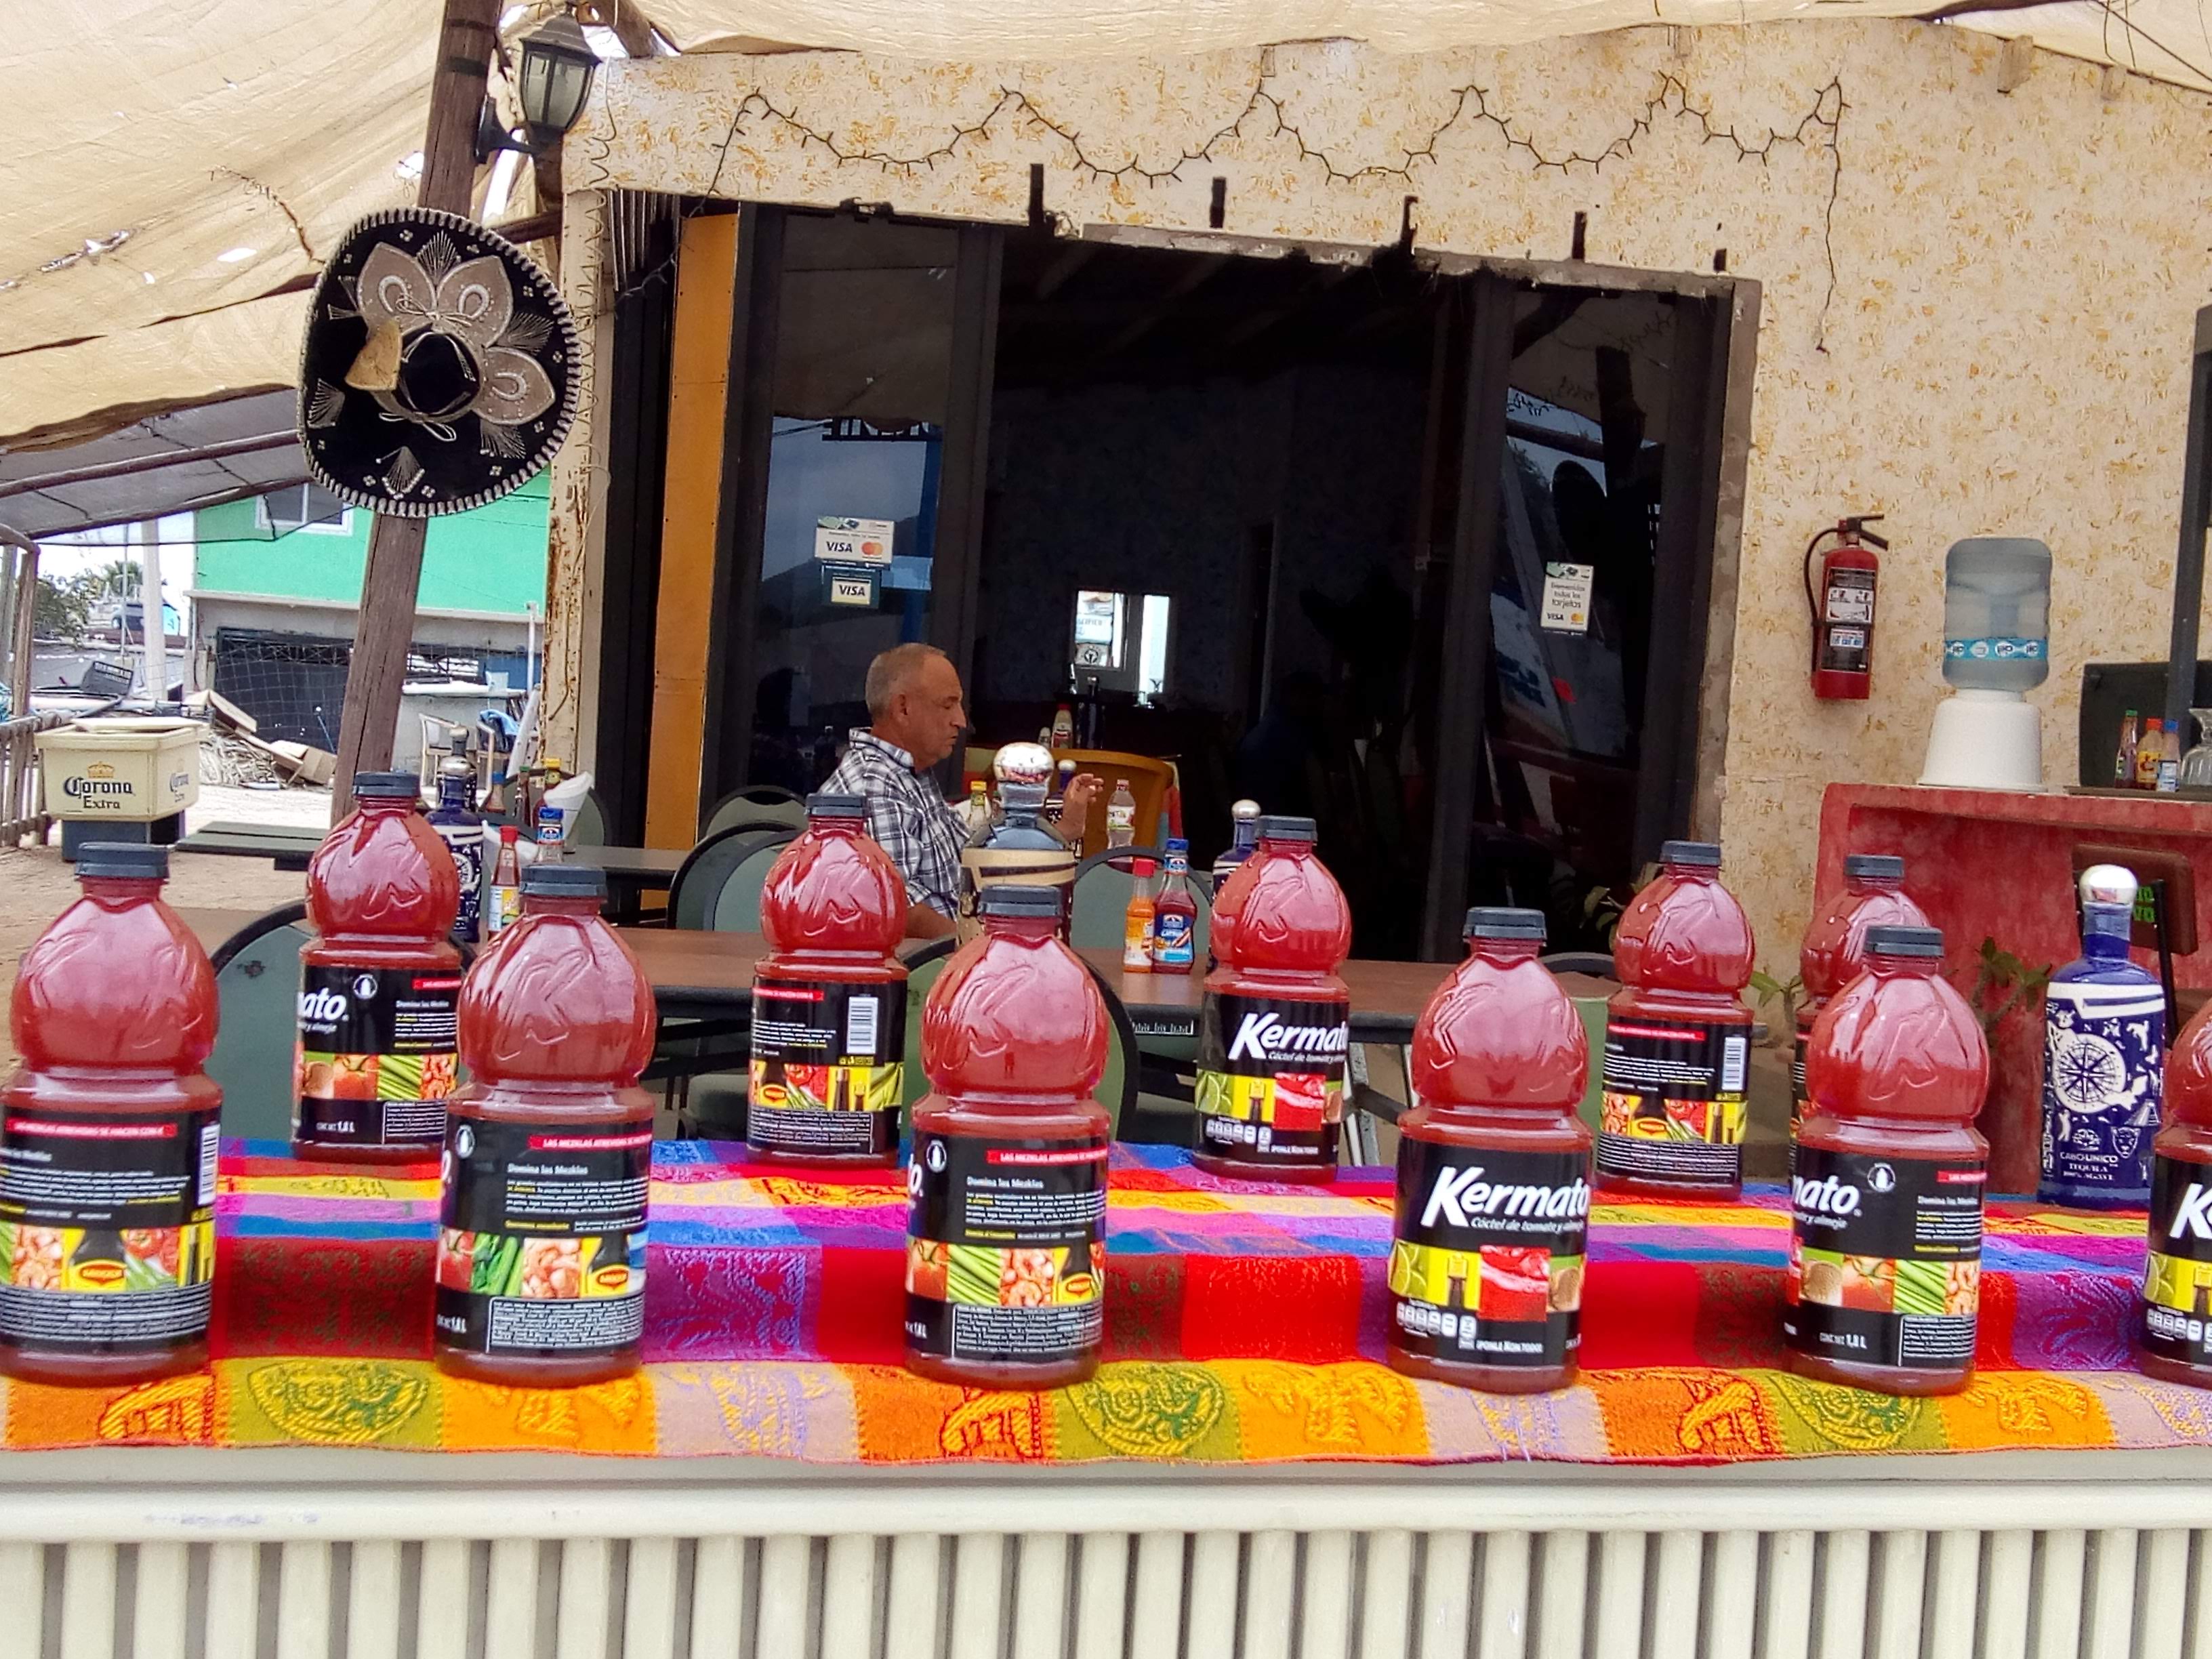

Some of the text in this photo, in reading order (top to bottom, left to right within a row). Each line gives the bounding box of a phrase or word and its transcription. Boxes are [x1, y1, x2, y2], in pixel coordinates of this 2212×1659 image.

[826, 541, 853, 554] VISA
[839, 585, 865, 597] VISA
[64, 776, 133, 799] Corona
[83, 796, 121, 809] Extra
